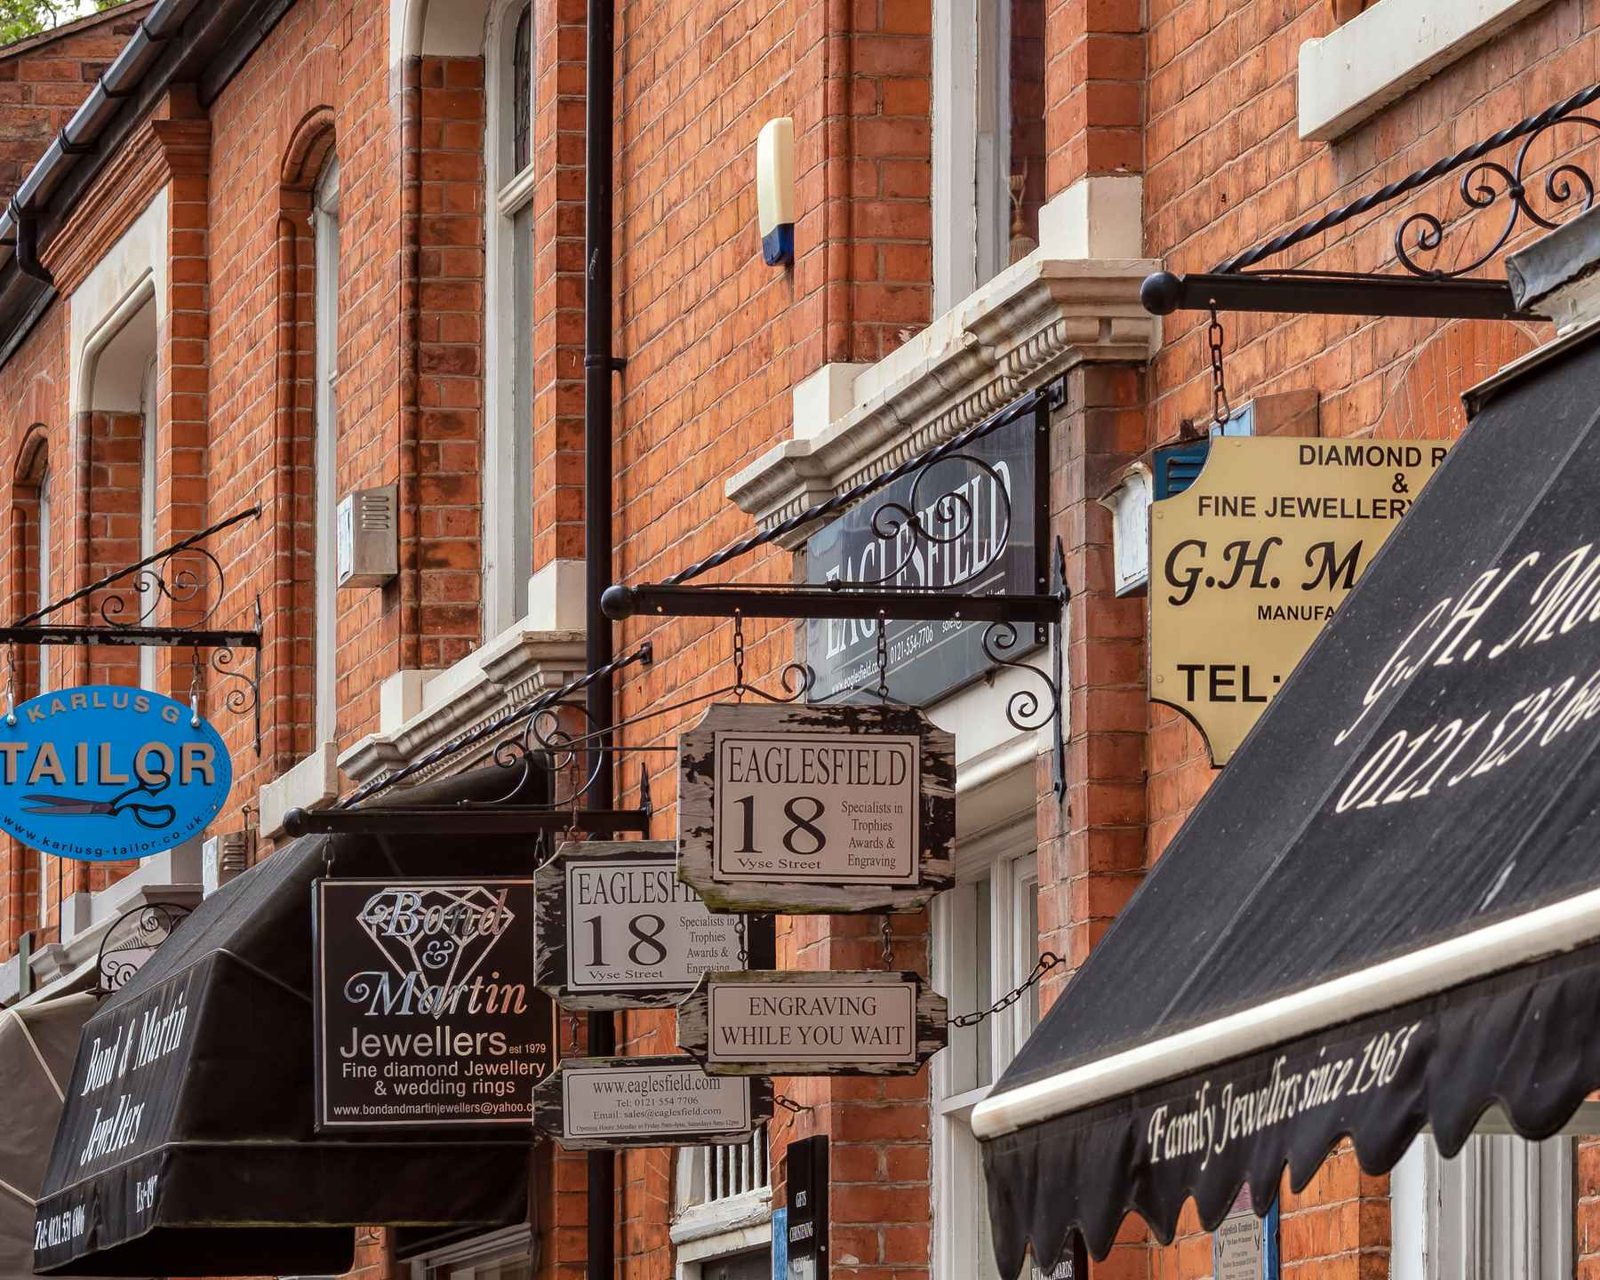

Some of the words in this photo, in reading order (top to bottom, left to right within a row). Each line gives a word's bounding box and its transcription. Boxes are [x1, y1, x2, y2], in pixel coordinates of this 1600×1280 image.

[1299, 445, 1422, 468] DIAMOND
[1392, 472, 1408, 493] &
[1199, 496, 1256, 517] FINE
[825, 460, 1011, 660] EAGLESFIELD
[1164, 536, 1283, 606] G.H.
[1301, 540, 1372, 592] M
[1258, 604, 1335, 621] MANUFA
[890, 625, 934, 665] 0121-554-7706
[1334, 551, 1540, 746] G.H.
[1177, 664, 1281, 703] TEL:
[27, 691, 150, 723] KARLUS
[161, 705, 181, 725] G
[1335, 711, 1491, 813] 0121
[1448, 676, 1576, 786] 523
[0, 741, 216, 785] TAILOR
[728, 746, 906, 786] EAGLESFIELD
[841, 801, 892, 815] Specialists
[894, 802, 903, 814] in
[3, 815, 204, 857] www.karlusg-tailor.co.uk
[734, 795, 827, 855] 18
[851, 818, 893, 833] Trophies
[848, 836, 884, 849] Awards
[886, 837, 896, 849] &
[738, 858, 774, 871] Vyse
[778, 858, 821, 870] Street
[848, 854, 897, 870] Engraving
[362, 888, 508, 937] Bond
[679, 916, 724, 929] Specialists
[726, 917, 735, 927] in
[583, 914, 667, 967] 18
[690, 932, 726, 944] Trophies
[422, 940, 455, 969] &
[686, 948, 719, 959] Awards
[720, 948, 729, 958] &
[588, 969, 621, 981] Vyse
[625, 969, 664, 980] Street
[344, 971, 527, 1016] Martin
[748, 996, 877, 1016] ENGRAVING
[81, 1026, 122, 1096] Bond
[118, 1018, 136, 1079] &
[132, 992, 188, 1071] Martin
[340, 1025, 507, 1058] Jewellers
[508, 1044, 523, 1055] est
[525, 1043, 546, 1054] 1979
[721, 1026, 792, 1046] WHILE
[797, 1026, 845, 1046] YOU
[850, 1025, 905, 1045] WAIT
[342, 1062, 377, 1078] Fine
[383, 1060, 458, 1078] diamond
[464, 1060, 545, 1078] Jewellery
[374, 1080, 387, 1096] &
[393, 1079, 466, 1098] wedding
[472, 1079, 515, 1096] rings
[593, 1074, 721, 1097] www.eaglesfield.com
[616, 1099, 632, 1108] Tel:
[634, 1098, 655, 1108] 0121
[659, 1097, 674, 1106] 554
[677, 1096, 699, 1105] 7706
[623, 1107, 722, 1119] sales@eaglesfield.com
[1147, 1080, 1217, 1172] Family
[1298, 1046, 1354, 1113] since
[80, 1094, 145, 1167] Jewellers
